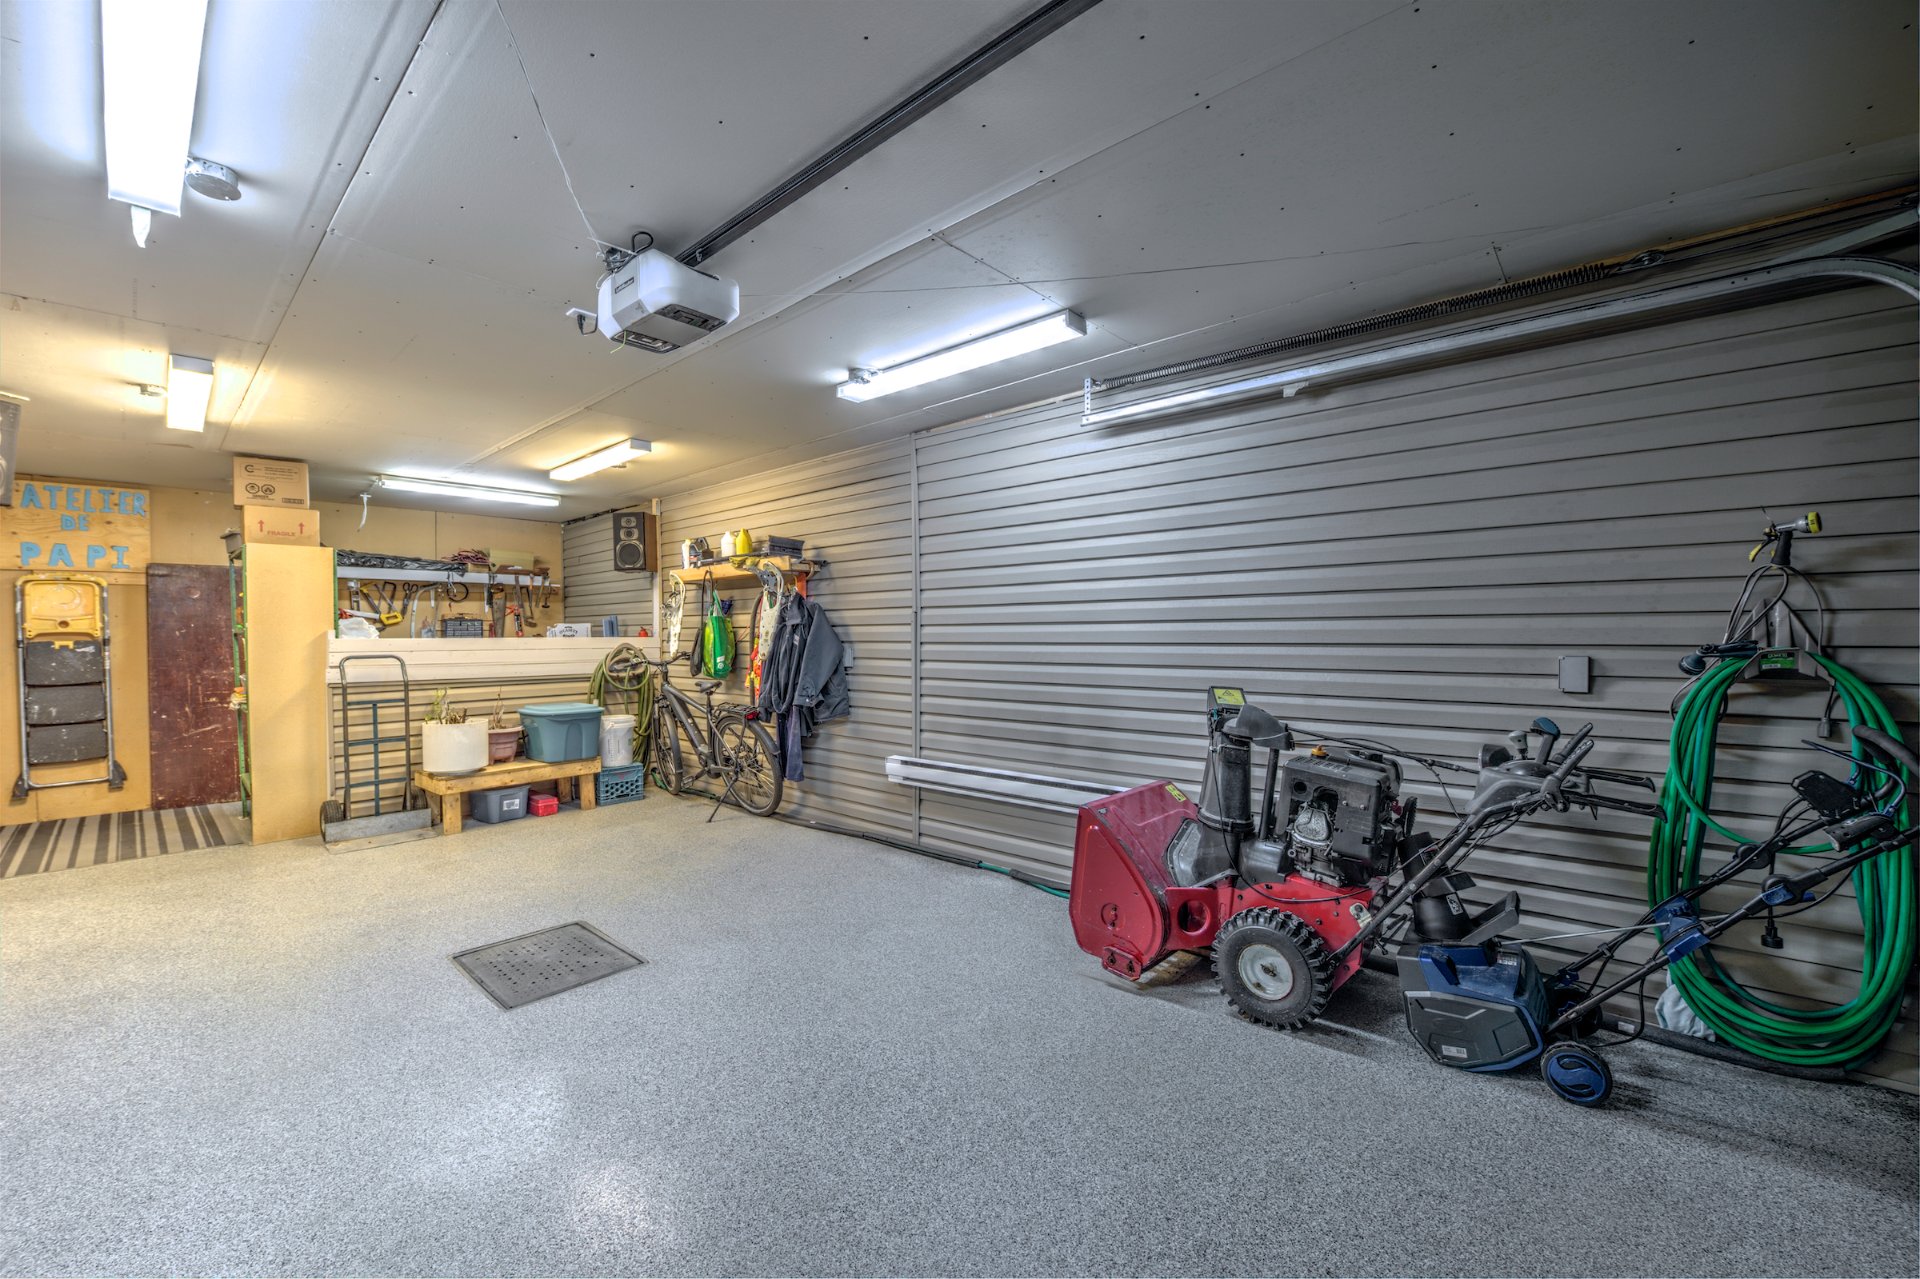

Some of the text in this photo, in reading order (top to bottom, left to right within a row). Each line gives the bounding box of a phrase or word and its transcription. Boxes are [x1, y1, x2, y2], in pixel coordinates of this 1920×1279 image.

[20, 483, 145, 516] ATELIER
[61, 514, 90, 531] DE
[20, 542, 129, 569] PAPI
